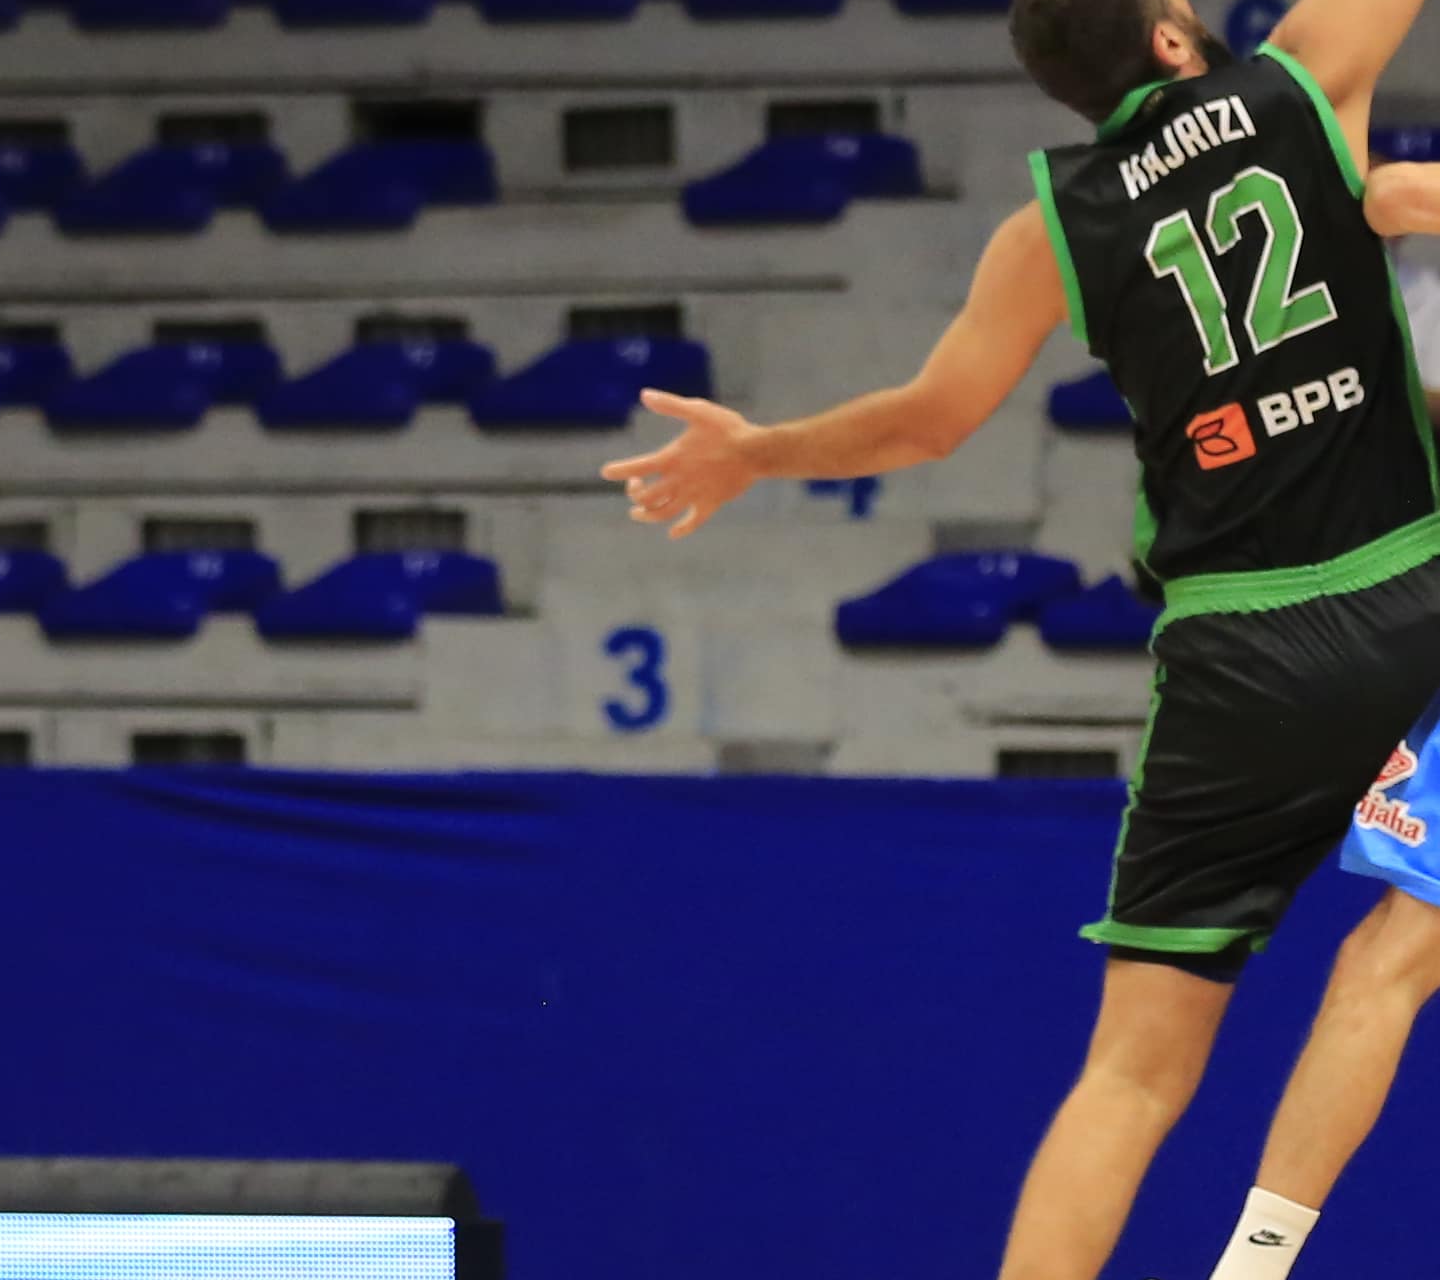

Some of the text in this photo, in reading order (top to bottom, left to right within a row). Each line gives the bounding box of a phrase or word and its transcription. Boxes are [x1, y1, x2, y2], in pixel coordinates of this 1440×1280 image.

[1118, 94, 1257, 201] KAJRIZI
[1144, 165, 1338, 377] 12
[1257, 365, 1365, 437] BPB
[602, 625, 669, 733] 3
